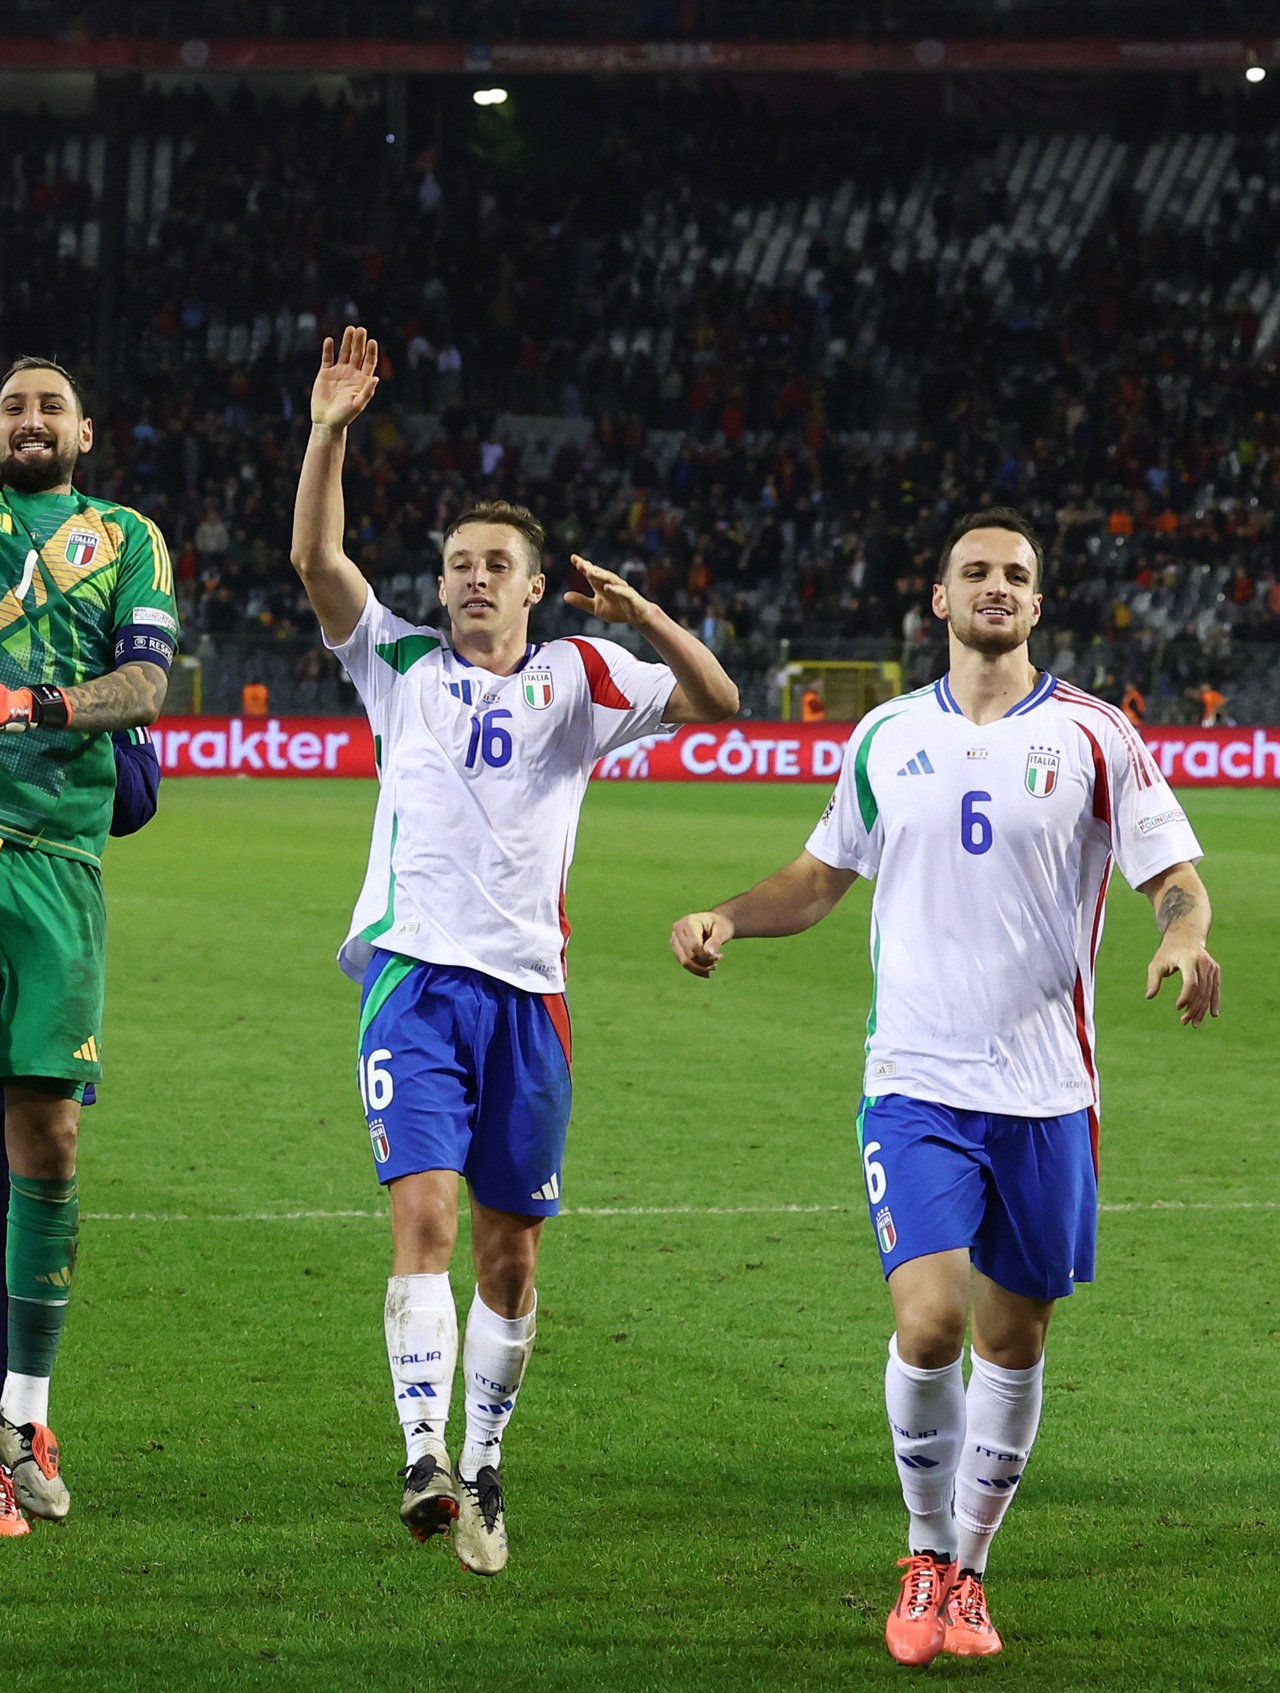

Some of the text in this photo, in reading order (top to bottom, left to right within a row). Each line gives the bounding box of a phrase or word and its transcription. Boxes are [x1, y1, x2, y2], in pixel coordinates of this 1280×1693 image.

[70, 533, 96, 546] ITALIA
[15, 549, 39, 600] 1
[524, 674, 549, 682] ITALIA
[464, 708, 513, 769] 16
[680, 728, 801, 776] CÔTE
[1030, 755, 1057, 767] ITALIA
[961, 790, 993, 856] 6
[864, 1141, 887, 1205] 6
[392, 1351, 442, 1366] ITALIA
